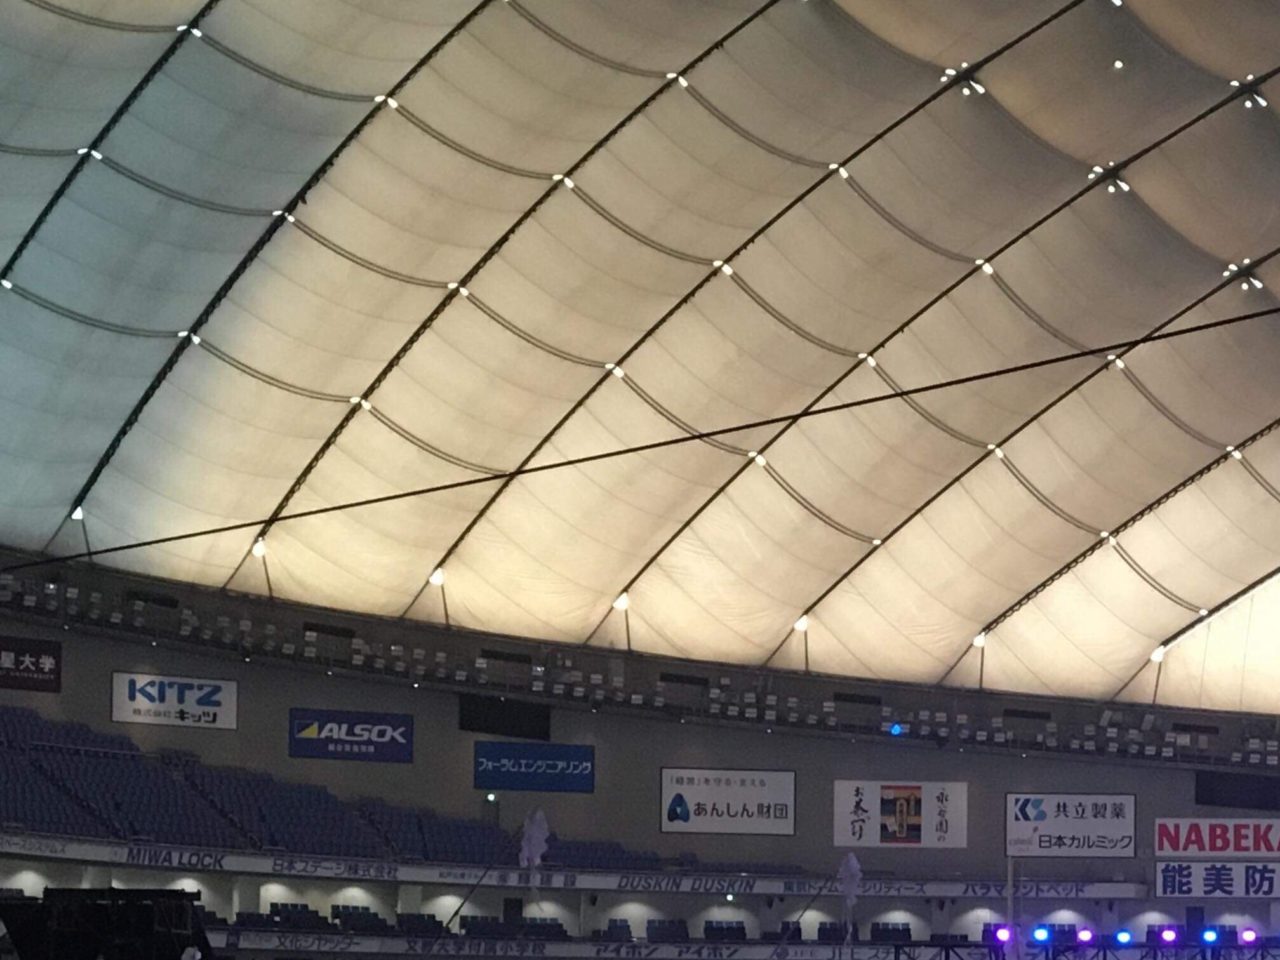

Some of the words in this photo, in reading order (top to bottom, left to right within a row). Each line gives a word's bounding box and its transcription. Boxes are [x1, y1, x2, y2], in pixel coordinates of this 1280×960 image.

[128, 679, 222, 707] KITZ
[319, 721, 407, 744] ALSOK
[478, 757, 592, 775] フォーラムエンジニアリング
[693, 801, 789, 820] あんしん財団
[1053, 801, 1127, 821] 共立製薬
[1038, 835, 1133, 850] 日本カルミック
[126, 847, 173, 866] MIWA
[177, 849, 225, 869] LOCK
[617, 873, 682, 891] DUSKIN
[690, 874, 757, 892] DUSKIN
